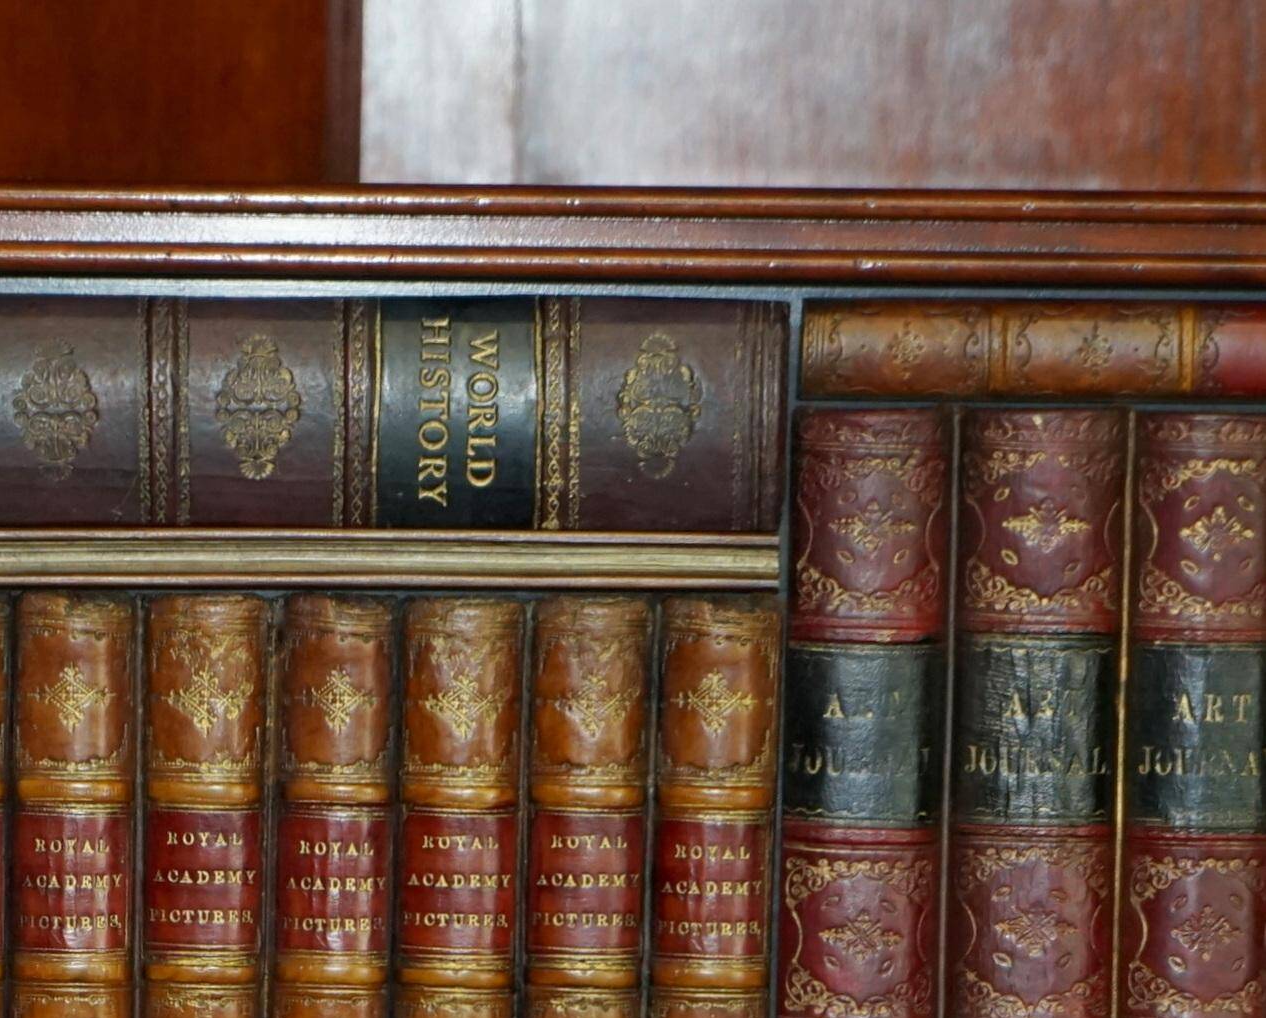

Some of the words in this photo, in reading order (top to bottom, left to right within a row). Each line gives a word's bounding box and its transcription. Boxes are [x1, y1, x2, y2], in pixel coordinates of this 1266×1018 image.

[418, 316, 451, 507] HISTORY
[466, 328, 499, 487] WORLD
[1172, 692, 1252, 724] ART
[34, 838, 110, 853] ROYAL
[167, 831, 243, 846] ROYAL
[422, 835, 499, 850] ROYAL
[551, 835, 627, 849] ROYAL
[299, 840, 374, 856] ROYAL
[674, 844, 750, 861] ROYAL
[22, 873, 122, 888] ACADEMY
[153, 869, 257, 884] ACADEMY
[407, 873, 511, 888] ACADEMY
[536, 873, 639, 888] ACADEMY
[287, 877, 386, 892] ACADEMY
[661, 881, 762, 896] ACADEMY
